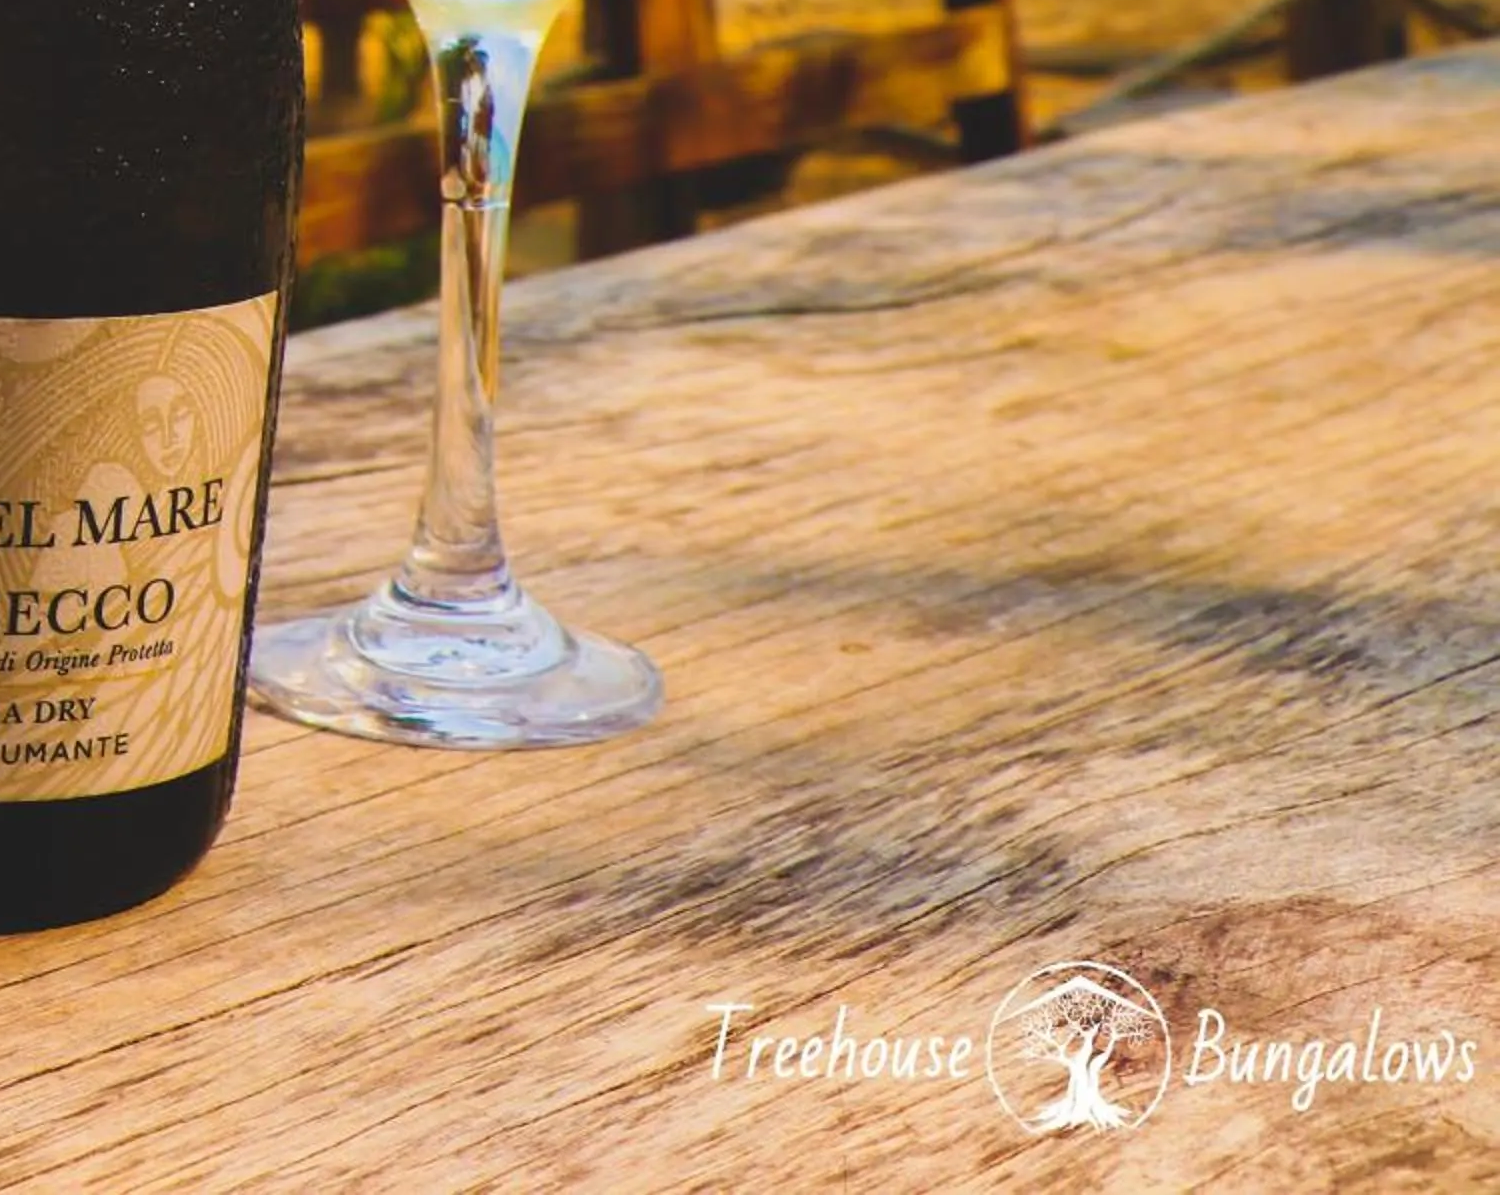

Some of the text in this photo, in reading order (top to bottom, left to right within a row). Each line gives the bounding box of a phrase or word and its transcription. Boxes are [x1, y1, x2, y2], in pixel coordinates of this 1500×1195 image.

[71, 478, 224, 548] MARE
[25, 649, 100, 677] Origine
[106, 639, 175, 666] Protetta
[32, 696, 97, 725] DRY
